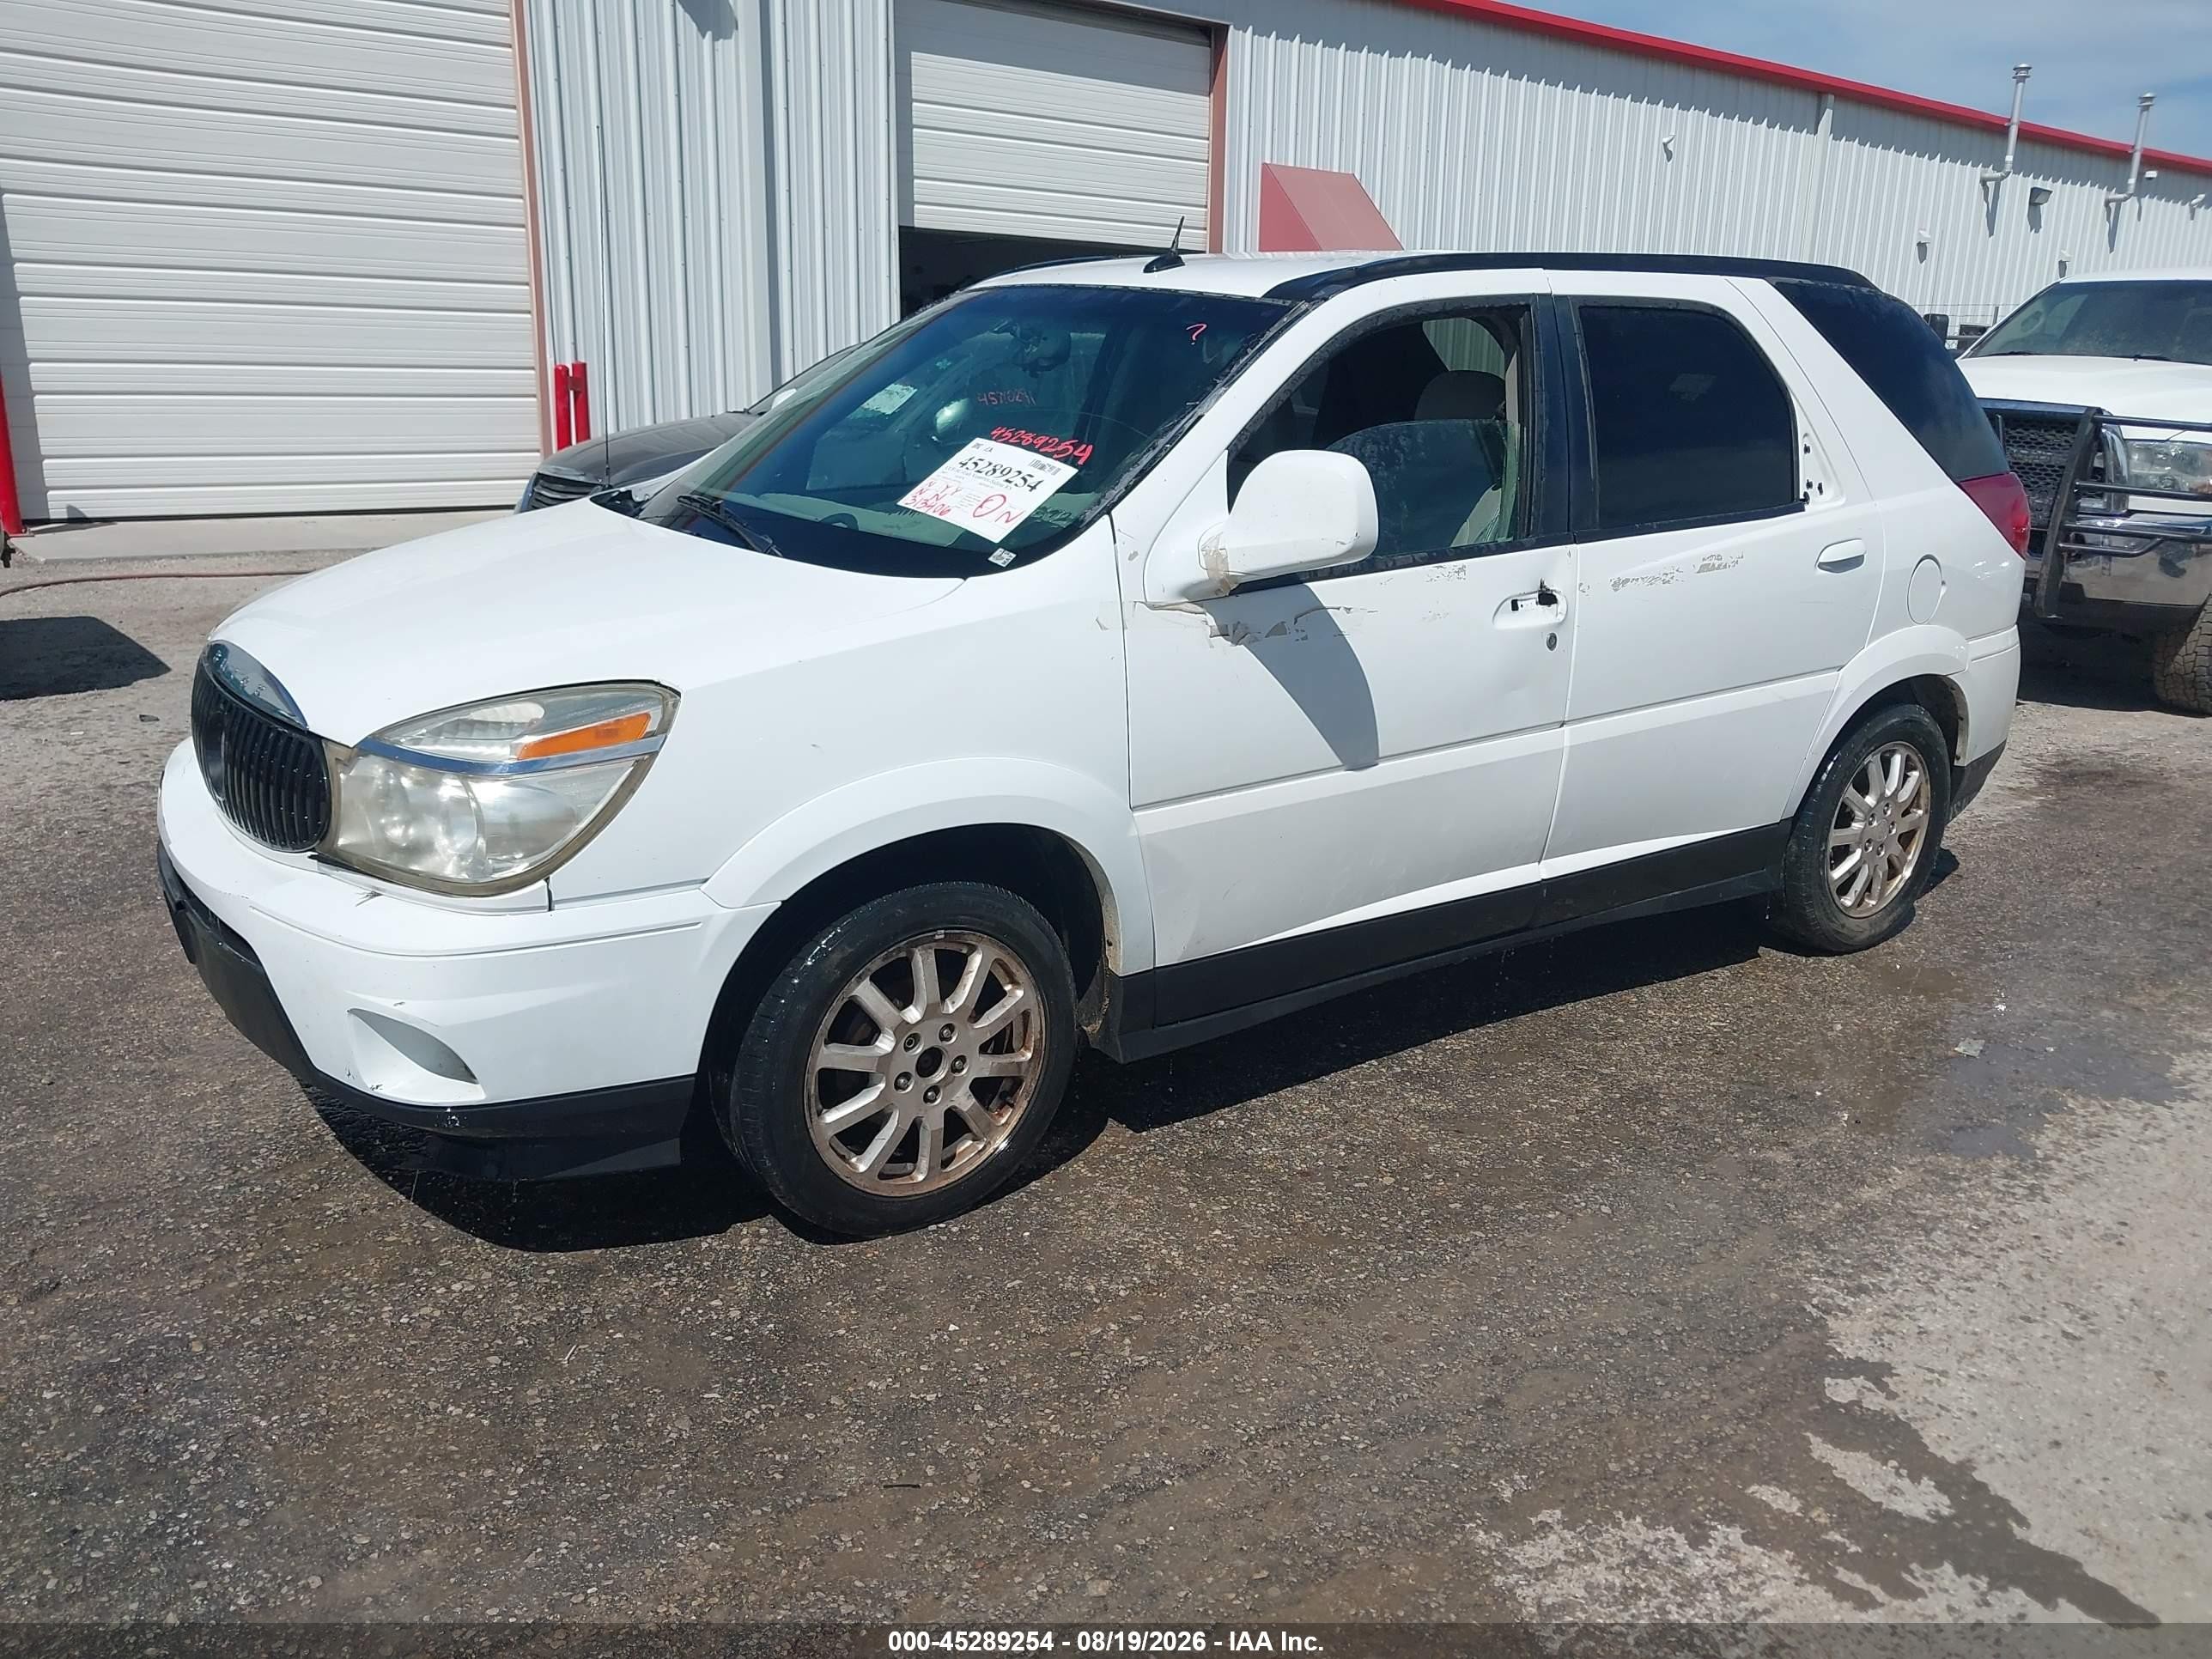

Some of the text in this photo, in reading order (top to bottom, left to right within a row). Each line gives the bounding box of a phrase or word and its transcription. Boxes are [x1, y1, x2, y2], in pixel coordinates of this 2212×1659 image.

[1186, 324, 1207, 345] ?
[990, 427, 1093, 465] 45289254
[958, 456, 1044, 492] 45289254
